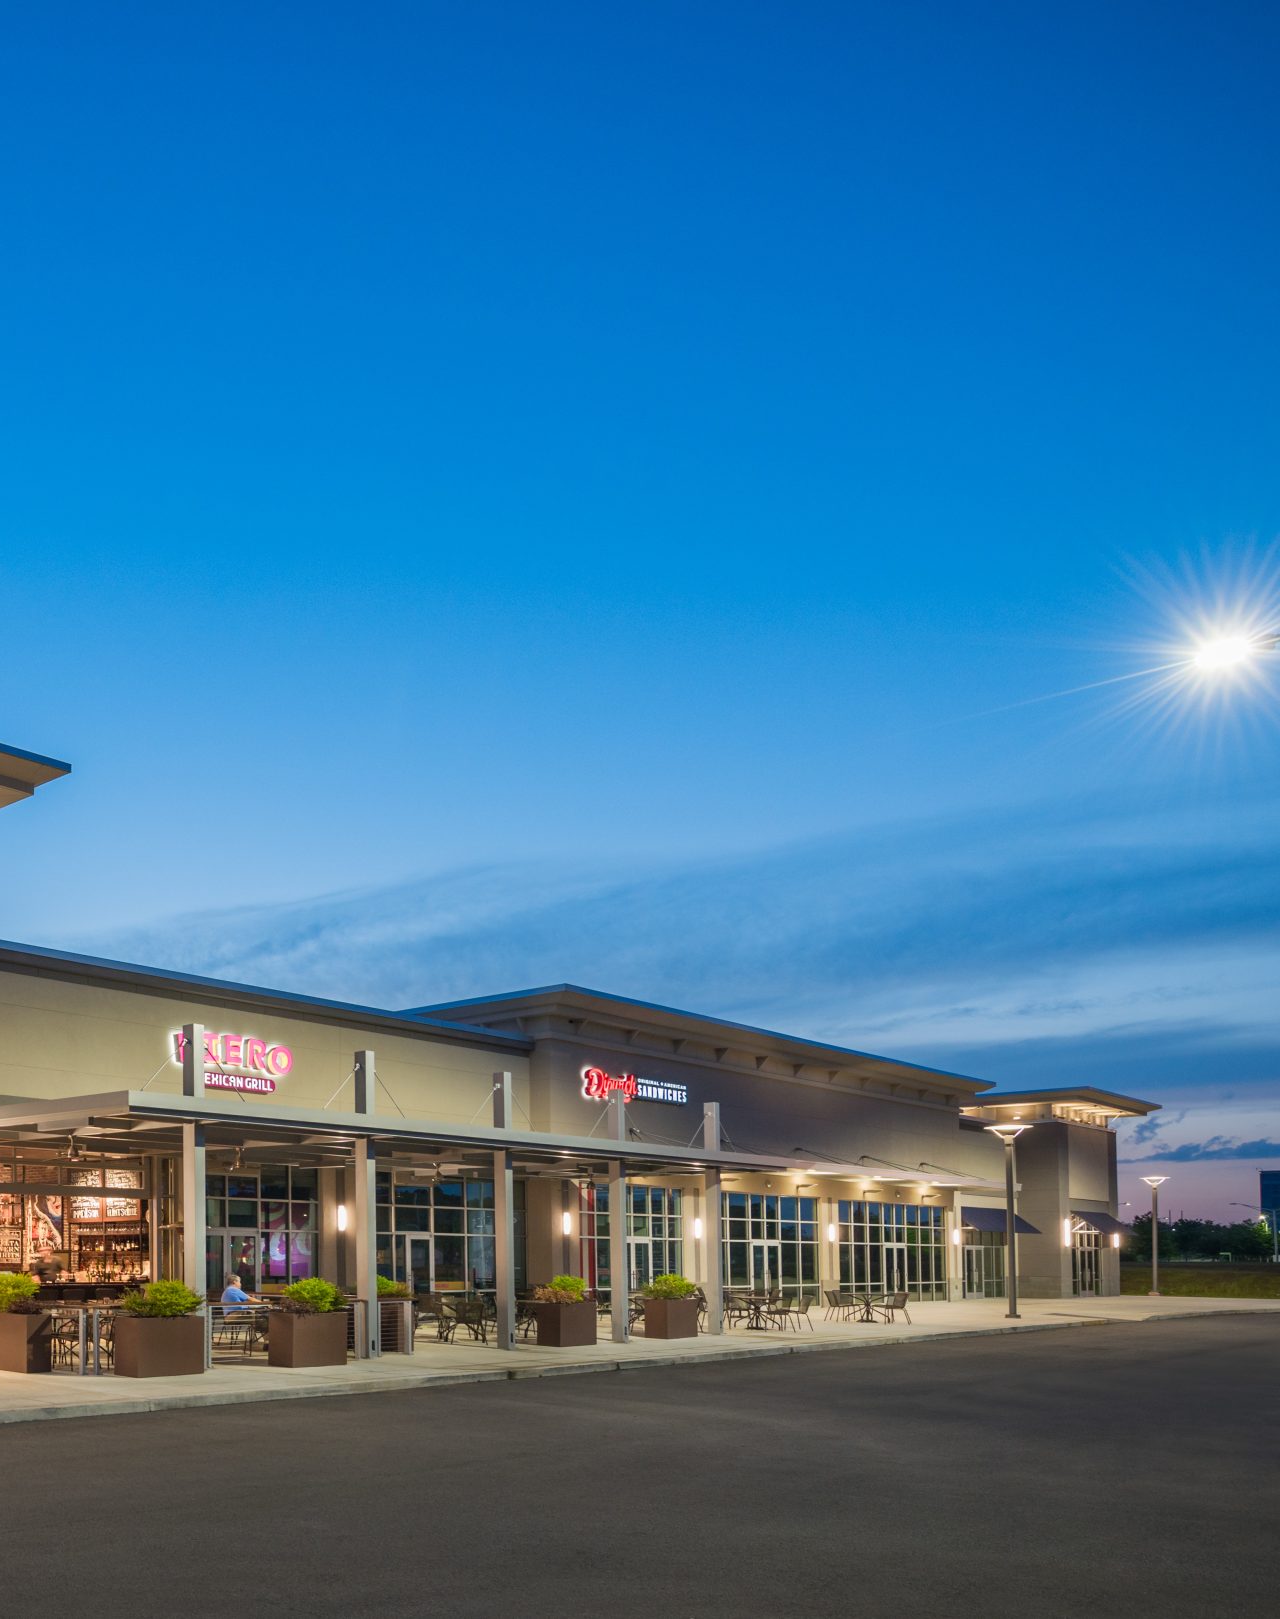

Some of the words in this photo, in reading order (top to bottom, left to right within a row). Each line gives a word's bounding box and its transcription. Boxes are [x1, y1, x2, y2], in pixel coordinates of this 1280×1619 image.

[204, 1072, 244, 1088] EXICAN
[245, 1077, 273, 1091] GRILL
[637, 1078, 660, 1086] ORIGINAL
[664, 1082, 687, 1090] AMERICAN
[637, 1085, 687, 1103] SANDWICHES
